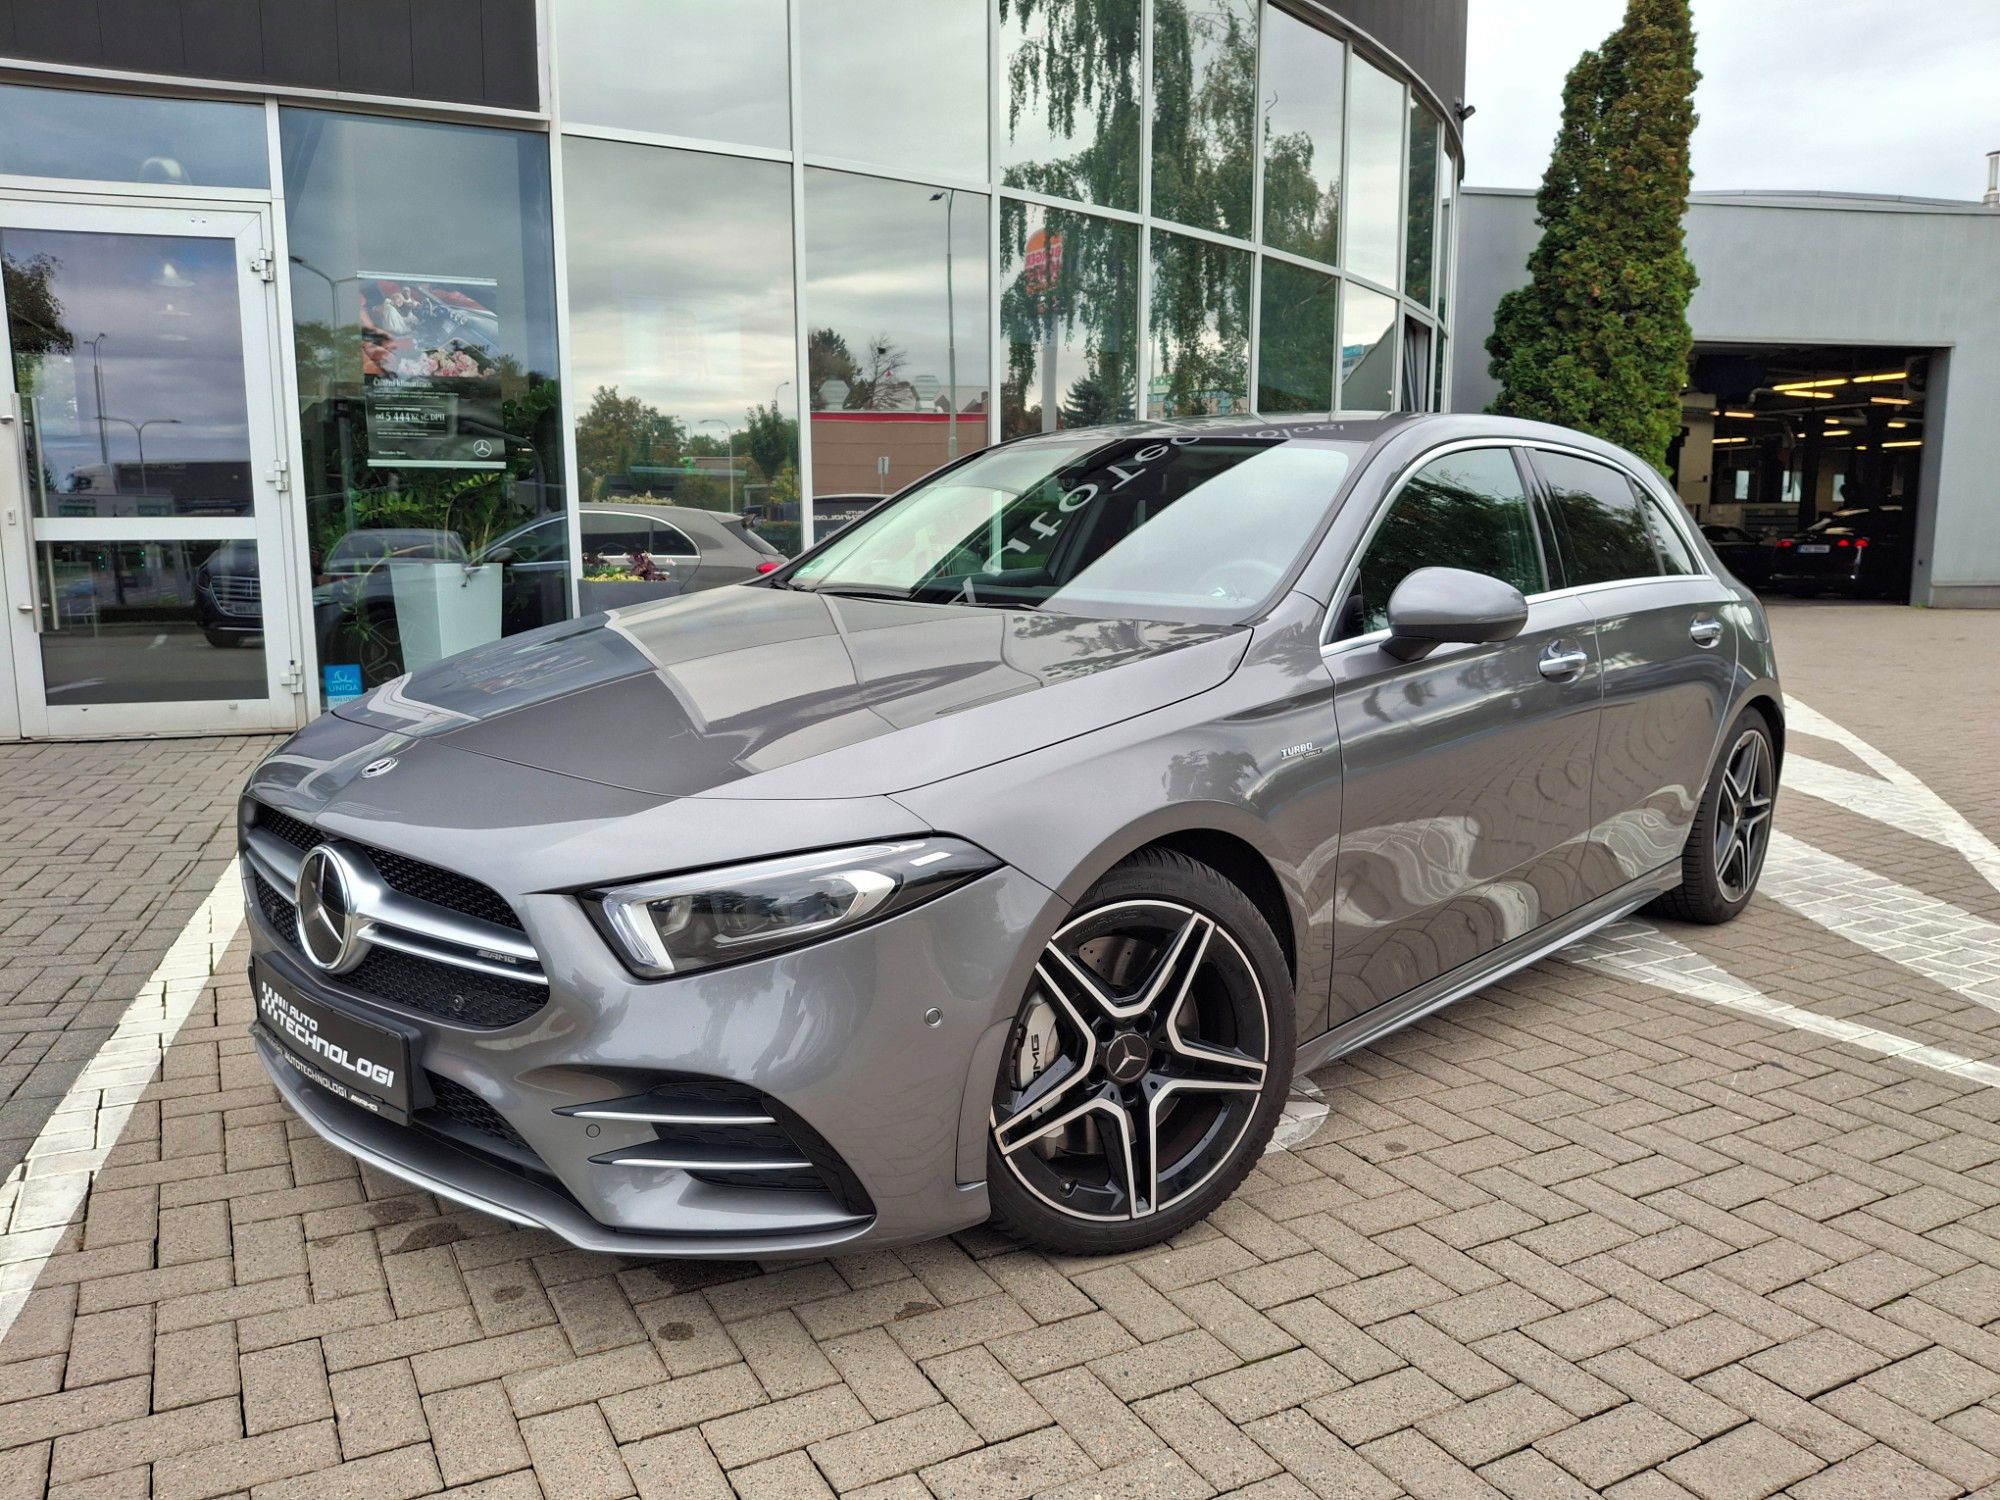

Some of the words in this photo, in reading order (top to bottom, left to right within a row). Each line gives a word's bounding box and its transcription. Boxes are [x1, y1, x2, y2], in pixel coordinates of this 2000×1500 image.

[328, 683, 359, 692] UNIQA
[1280, 741, 1313, 757] TURBO
[488, 952, 517, 964] AMG
[289, 1005, 319, 1032] AUTO
[277, 1009, 395, 1088] TECHNOLOGI
[284, 1051, 348, 1098] AUTOTECHNOLOGI
